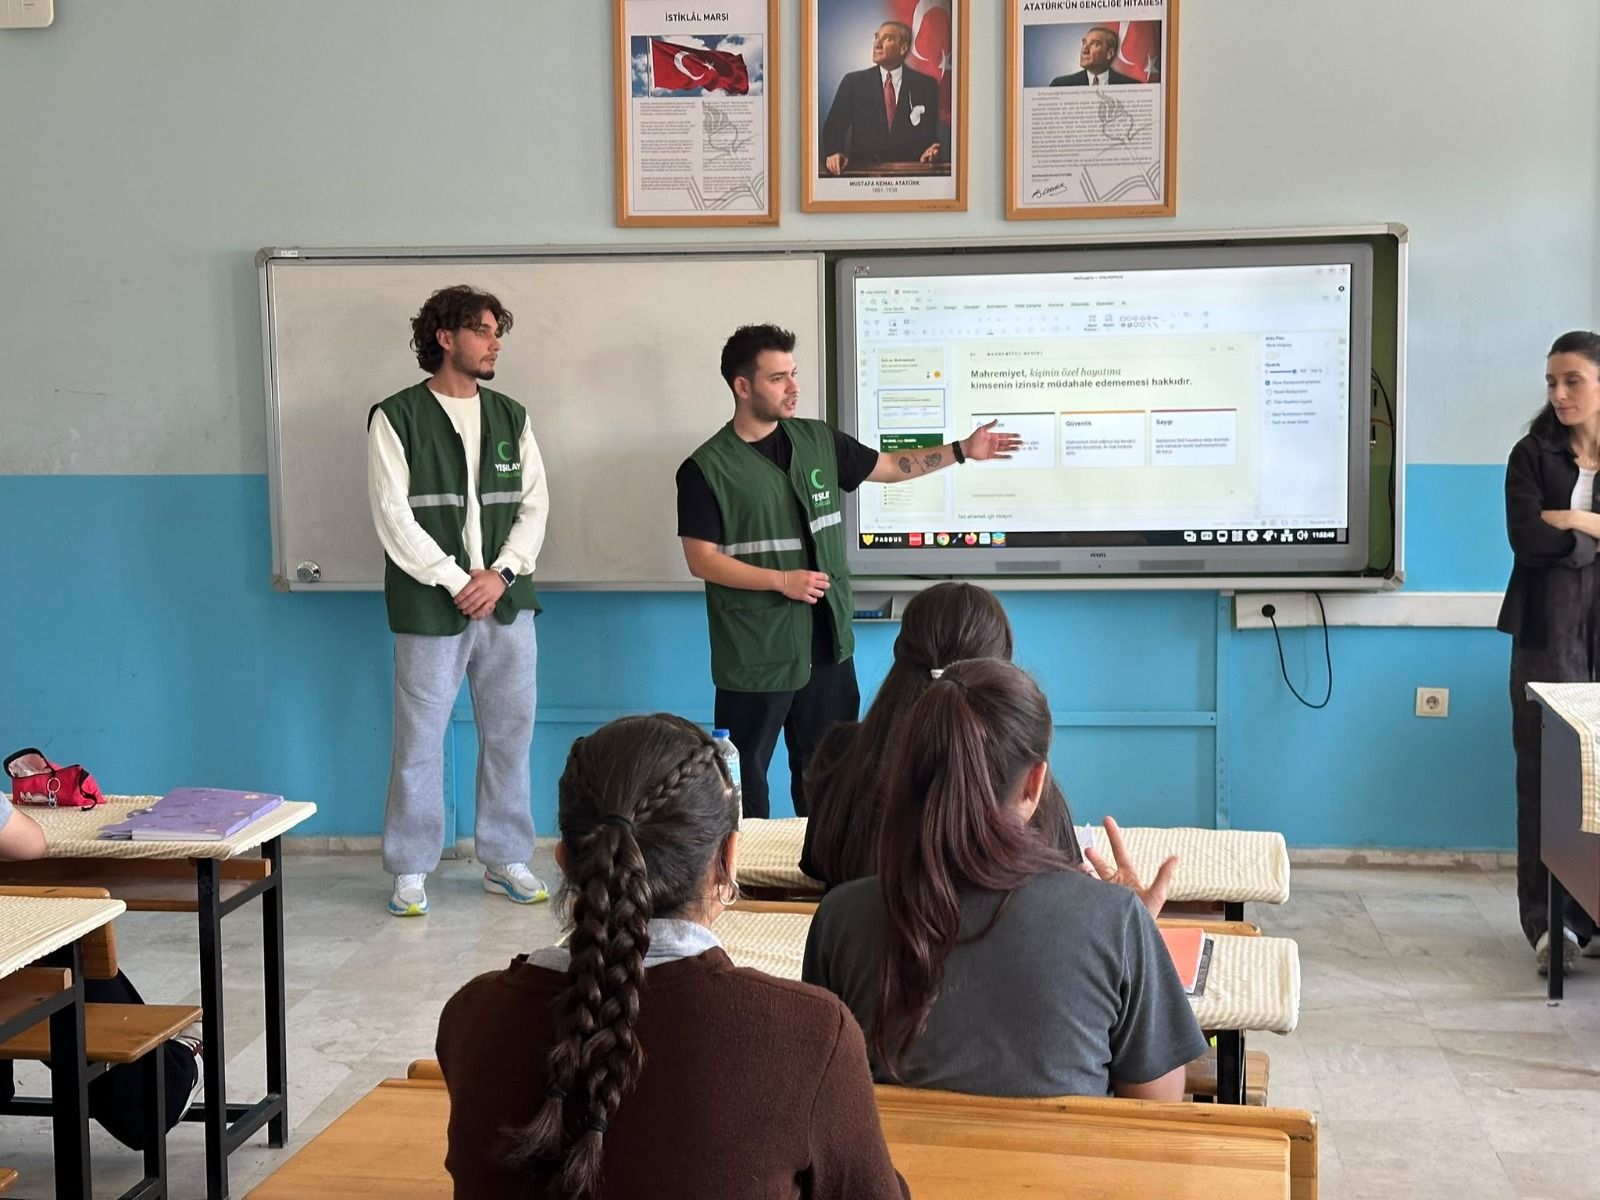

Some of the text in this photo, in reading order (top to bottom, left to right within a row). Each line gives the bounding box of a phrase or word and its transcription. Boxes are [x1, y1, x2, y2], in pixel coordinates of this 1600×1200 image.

[1024, 0, 1078, 11] ATATÜRK'ÜN
[665, 11, 729, 22] İSTİKLÂL MARŞI
[970, 366, 1121, 379] Mahremiyet, kişinin özel hayatına
[970, 376, 1193, 389] kimsenin izinsiz müdahale edememesi hakkıdır.
